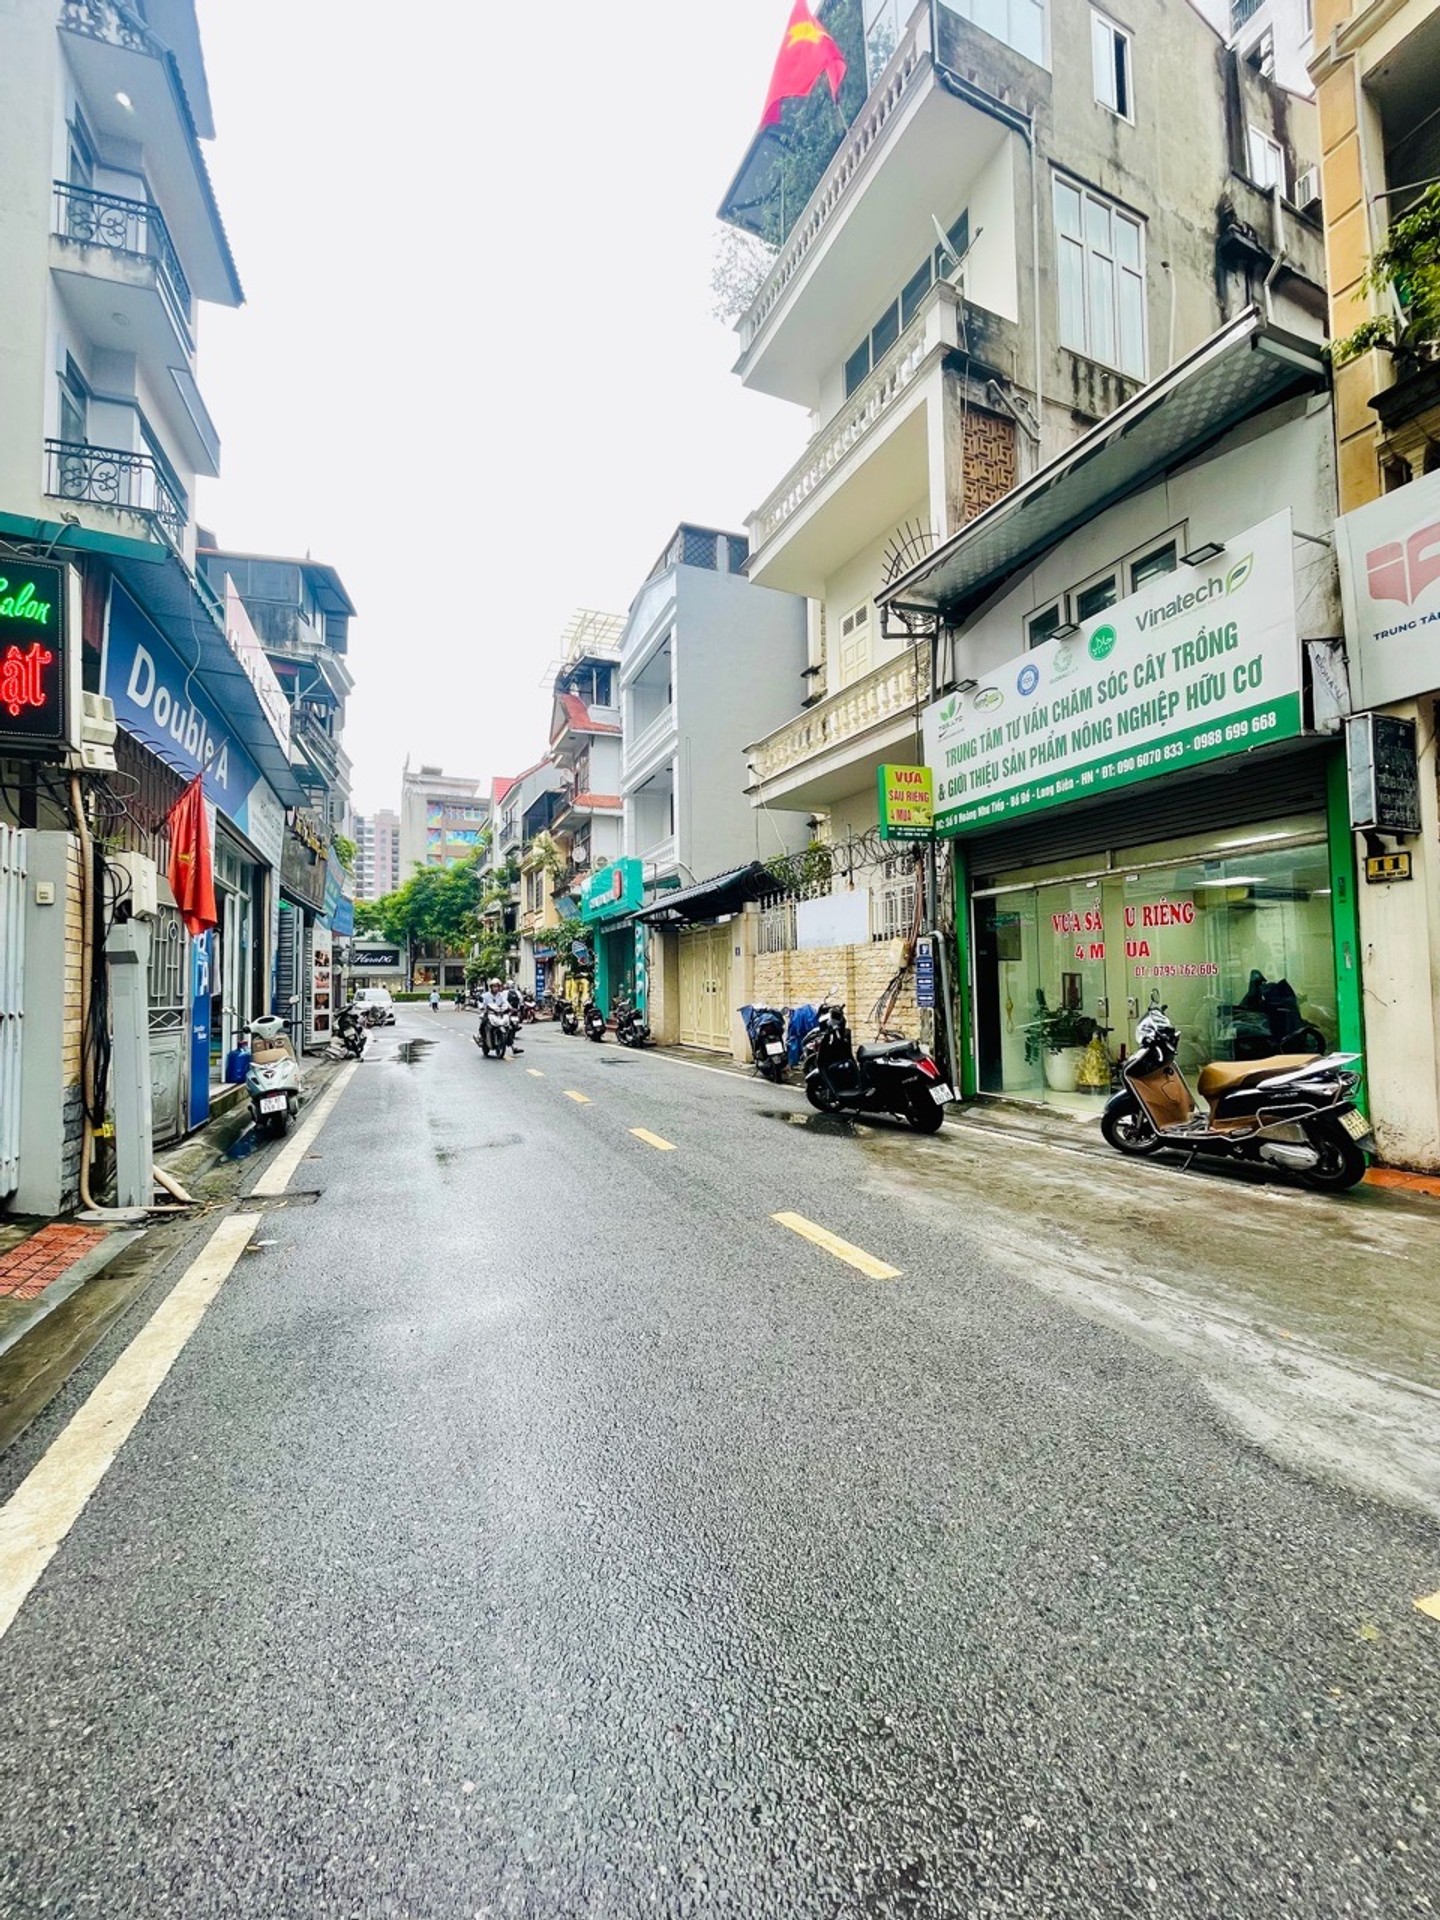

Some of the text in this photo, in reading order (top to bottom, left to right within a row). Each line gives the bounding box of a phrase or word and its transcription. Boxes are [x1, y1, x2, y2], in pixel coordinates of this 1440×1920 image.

[1135, 577, 1223, 633] Vinatech
[1373, 621, 1417, 641] TRUNG
[945, 738, 977, 768] TRUNG
[980, 726, 1003, 753] TÂM
[1006, 716, 1021, 742] TƯ
[1023, 702, 1049, 735] VẤN
[1052, 685, 1093, 723] CHĂM
[1097, 670, 1128, 704] SÓC
[1133, 651, 1166, 689] CÂY
[1172, 621, 1238, 673] TRỒNG
[126, 643, 228, 790] Double A
[938, 654, 1263, 801] & GIỚI THIỆU SẢN PHẨM NÔNG NGHIỆP HỮU CƠ
[1036, 784, 1054, 800] Long
[1056, 778, 1074, 793] Biên
[1081, 769, 1094, 786] HN
[1117, 756, 1135, 775] 090
[1137, 748, 1161, 767] 6070
[1163, 741, 1183, 760] 833
[1193, 729, 1222, 751] 0988
[1225, 720, 1248, 742] 699
[1251, 711, 1277, 733] 668
[895, 770, 922, 785] VỰA
[1375, 856, 1402, 871] 11
[1052, 911, 1081, 938] VỰA
[1142, 895, 1195, 927] RIÊNG
[1074, 944, 1085, 961] 4
[1153, 964, 1176, 977] 0795
[1180, 963, 1196, 976] 762
[1199, 962, 1218, 976] 605
